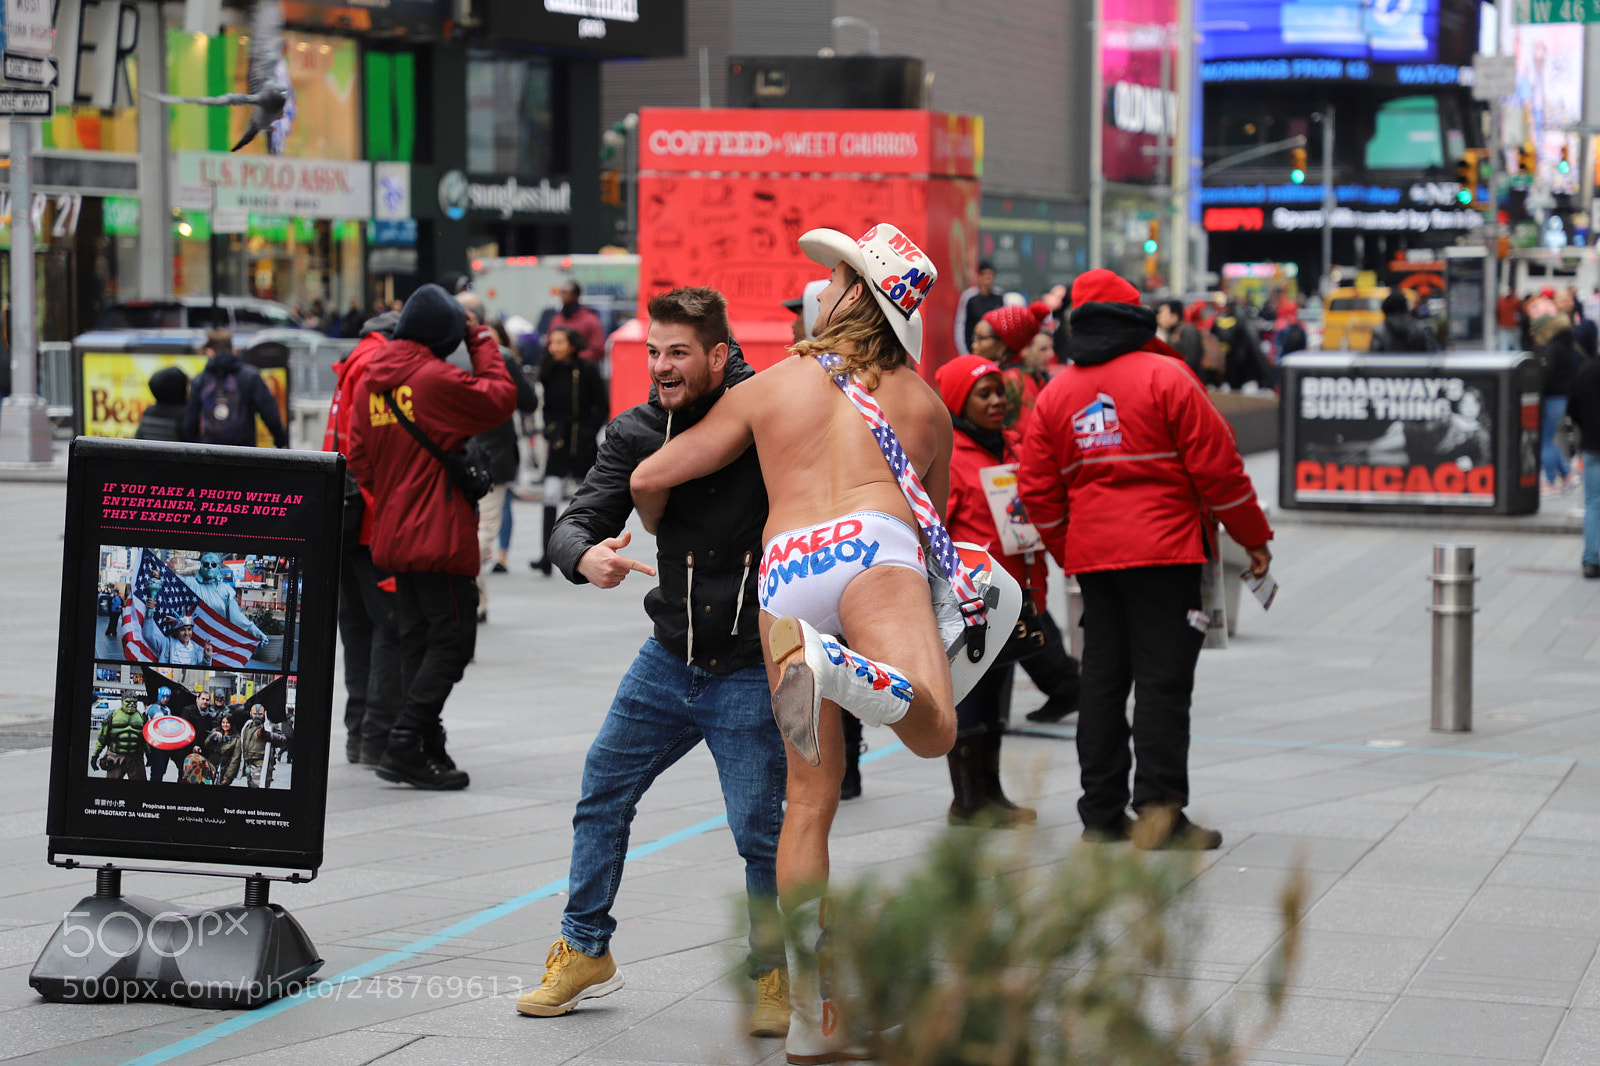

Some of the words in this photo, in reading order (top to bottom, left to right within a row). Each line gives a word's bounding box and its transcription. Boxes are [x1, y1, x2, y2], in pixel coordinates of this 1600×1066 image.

[1560, 0, 1585, 22] 46
[241, 164, 294, 191] POLO
[888, 233, 923, 262] NYC
[1301, 377, 1464, 401] BROADWAY'S
[91, 389, 148, 424] Bea
[1301, 398, 1369, 421] SURE
[1372, 398, 1451, 421] THING
[1296, 460, 1495, 495] CHICAGO
[102, 482, 117, 492] IF
[120, 484, 147, 494] YOU
[150, 485, 184, 497] TAKE
[186, 488, 195, 497] A
[199, 488, 242, 500] PHOTO
[246, 491, 281, 503] WITH
[283, 495, 303, 504] AN
[102, 496, 197, 512] ENTERTAINER,
[200, 502, 249, 514] PLEASE
[252, 505, 287, 517] NOTE
[102, 509, 138, 520] THEY
[139, 511, 191, 523] EXPECT
[193, 514, 202, 524] A
[206, 515, 228, 526] TIP
[759, 520, 863, 580] NAKED
[142, 802, 166, 810] Propinas
